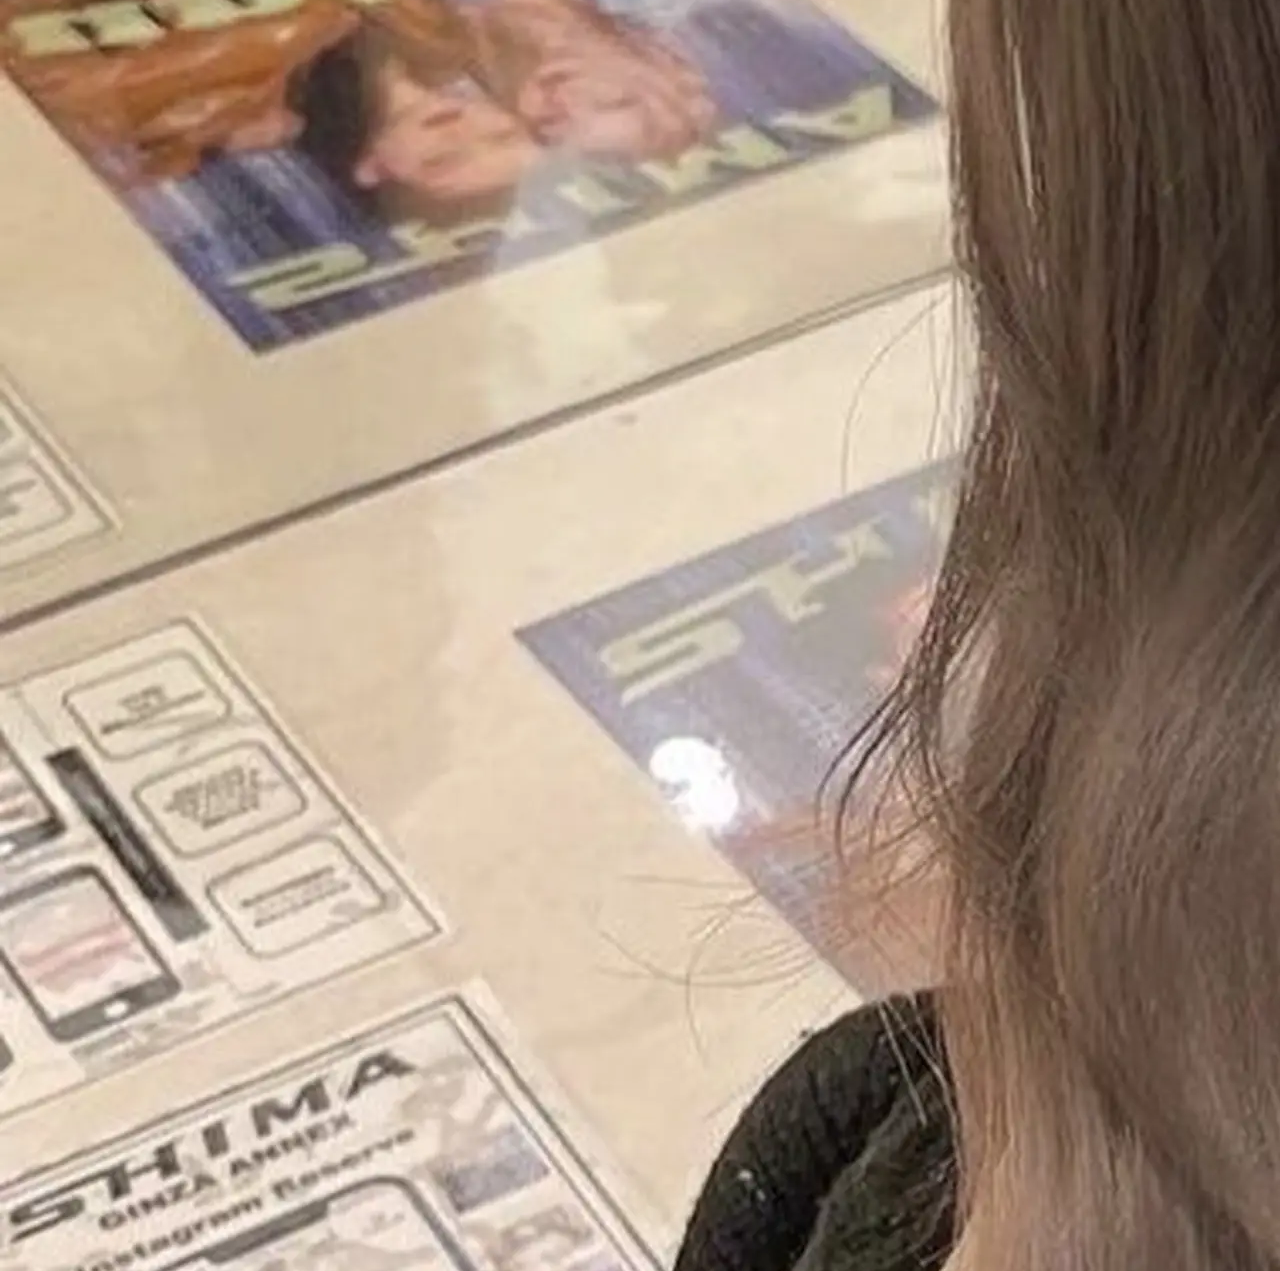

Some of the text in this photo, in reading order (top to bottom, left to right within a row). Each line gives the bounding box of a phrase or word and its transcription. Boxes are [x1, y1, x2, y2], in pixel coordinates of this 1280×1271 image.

[9, 1049, 417, 1244] SHIMA
[99, 1112, 354, 1231] GINZA ANNEX
[272, 1128, 416, 1199] Reserve
